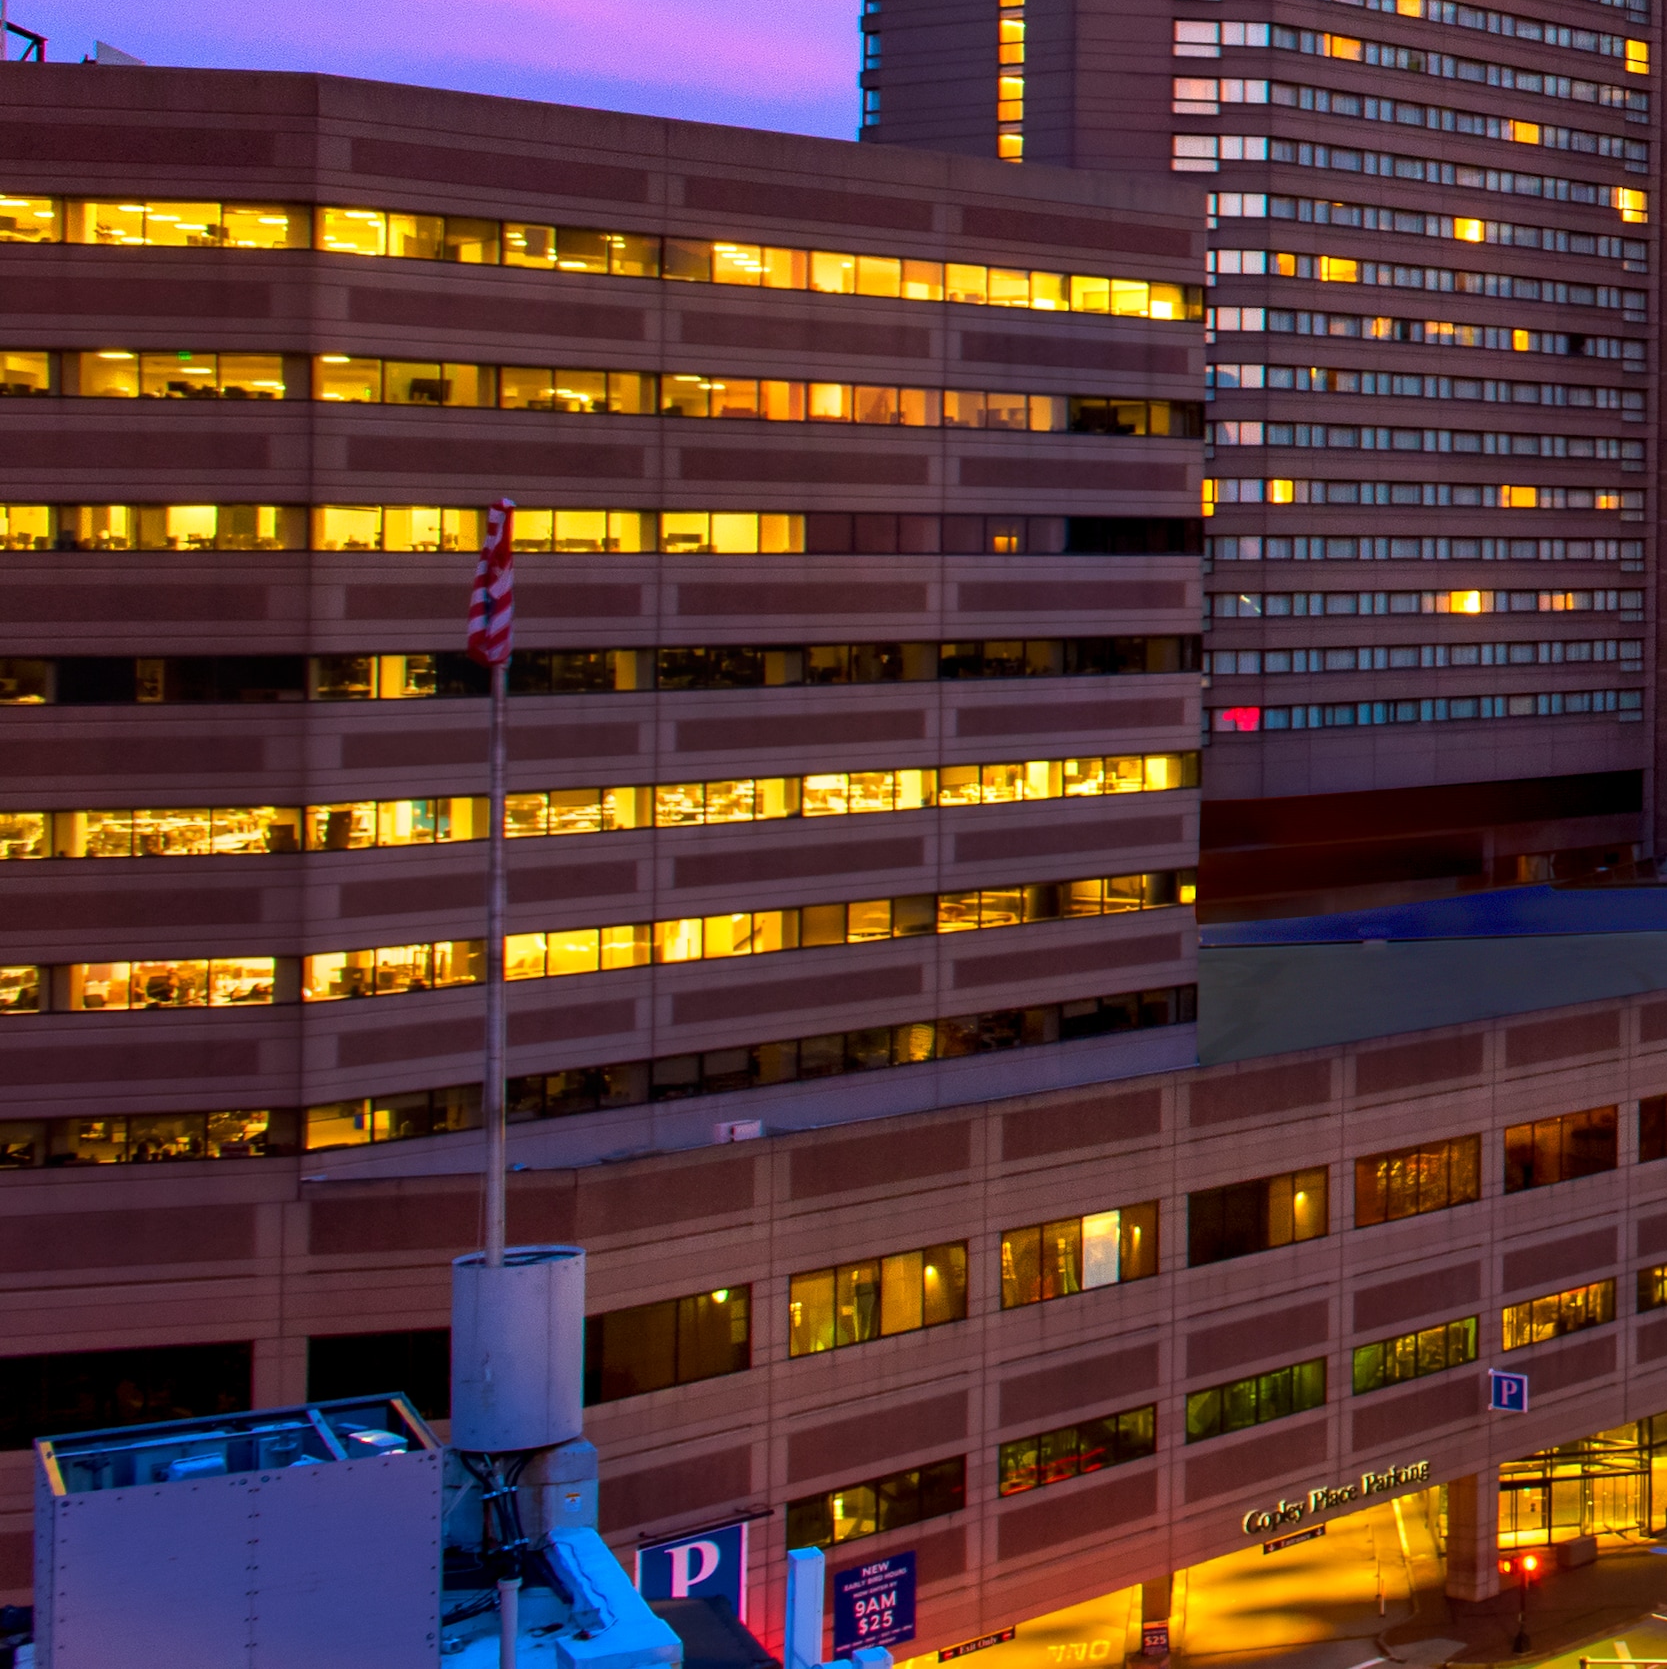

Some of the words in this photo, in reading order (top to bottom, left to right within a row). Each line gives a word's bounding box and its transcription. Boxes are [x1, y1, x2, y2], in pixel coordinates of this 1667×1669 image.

[1501, 1379, 1517, 1406] P
[1243, 1498, 1305, 1534] Copley
[1308, 1485, 1358, 1515] Place
[1361, 1460, 1430, 1496] Parking
[664, 1540, 720, 1598] P
[862, 1560, 890, 1577] NEW
[855, 1590, 896, 1618] 9AM
[858, 1610, 893, 1636] $25
[1144, 1634, 1167, 1647] $25
